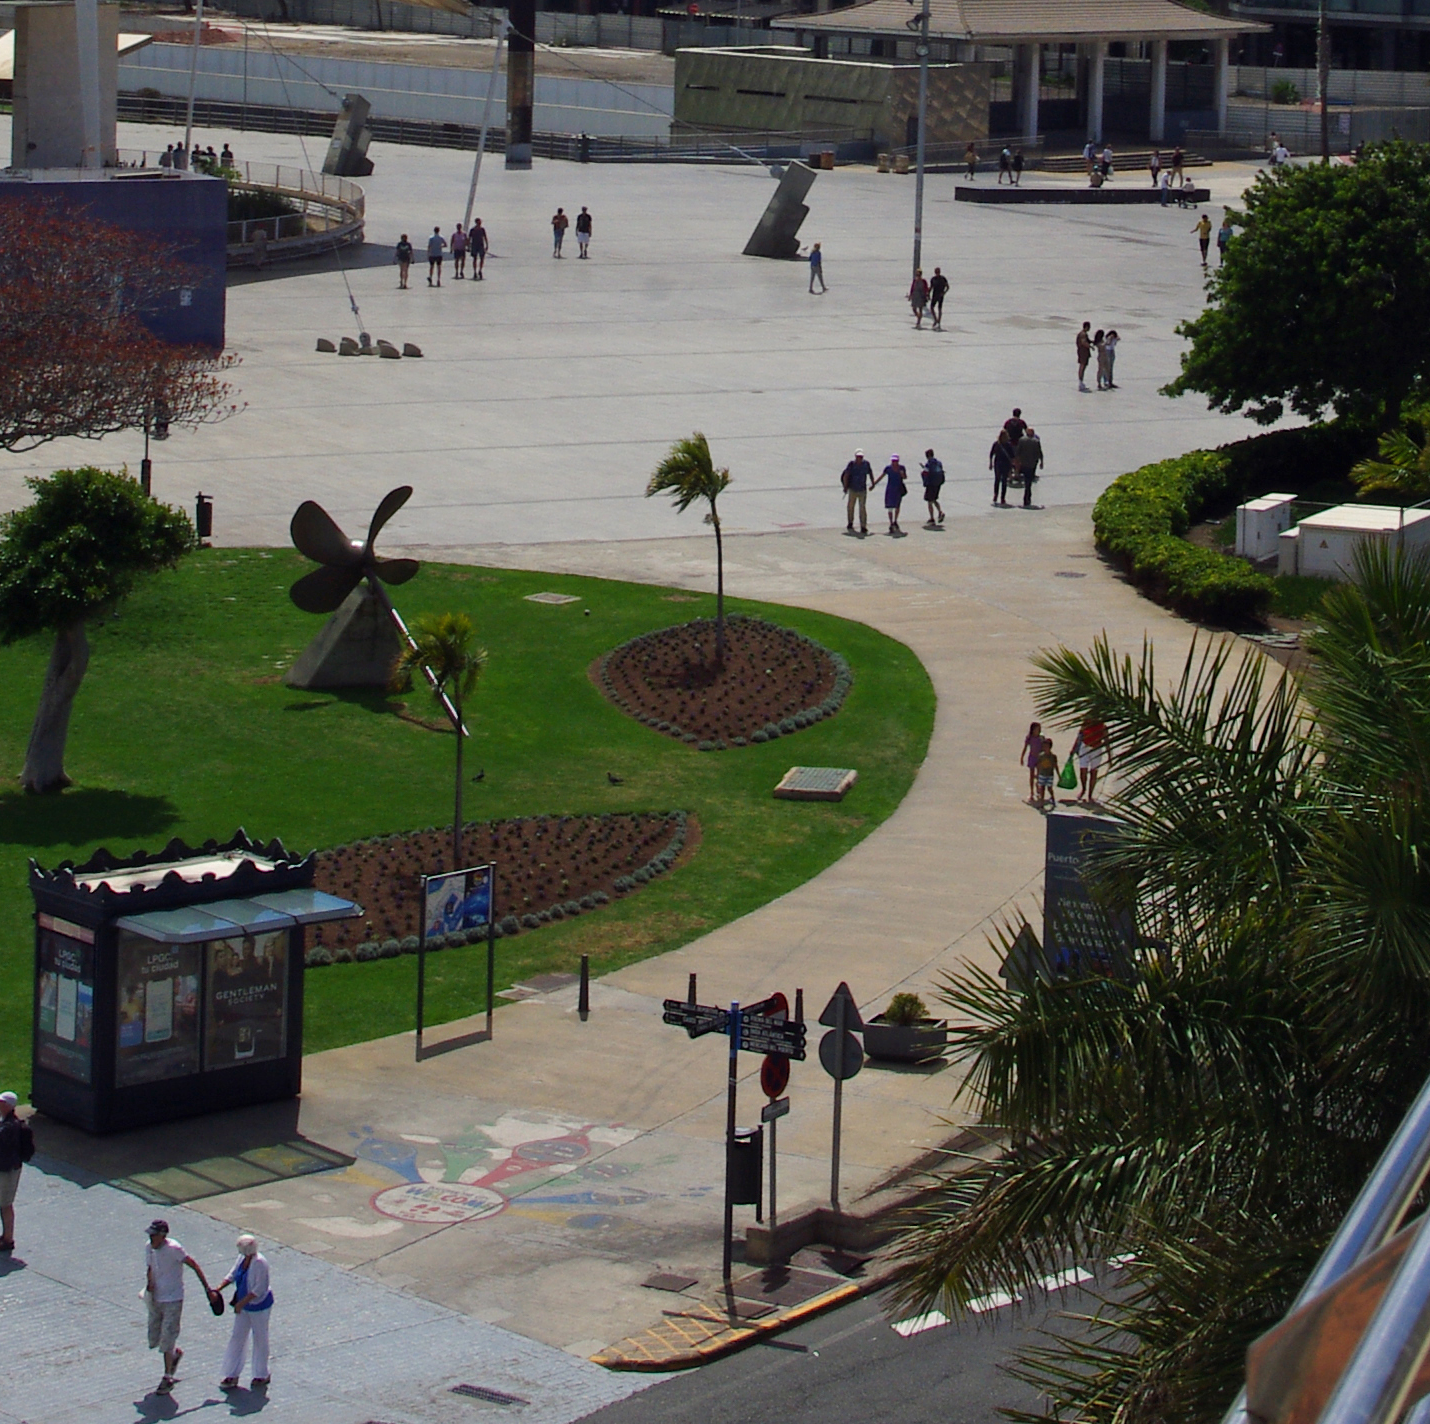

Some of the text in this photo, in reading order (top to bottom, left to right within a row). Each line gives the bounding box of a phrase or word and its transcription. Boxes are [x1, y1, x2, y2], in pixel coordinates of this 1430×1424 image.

[1047, 851, 1080, 865] Puerto
[215, 982, 277, 1000] GENTLEMAN
[227, 992, 265, 1007] SOCIETY
